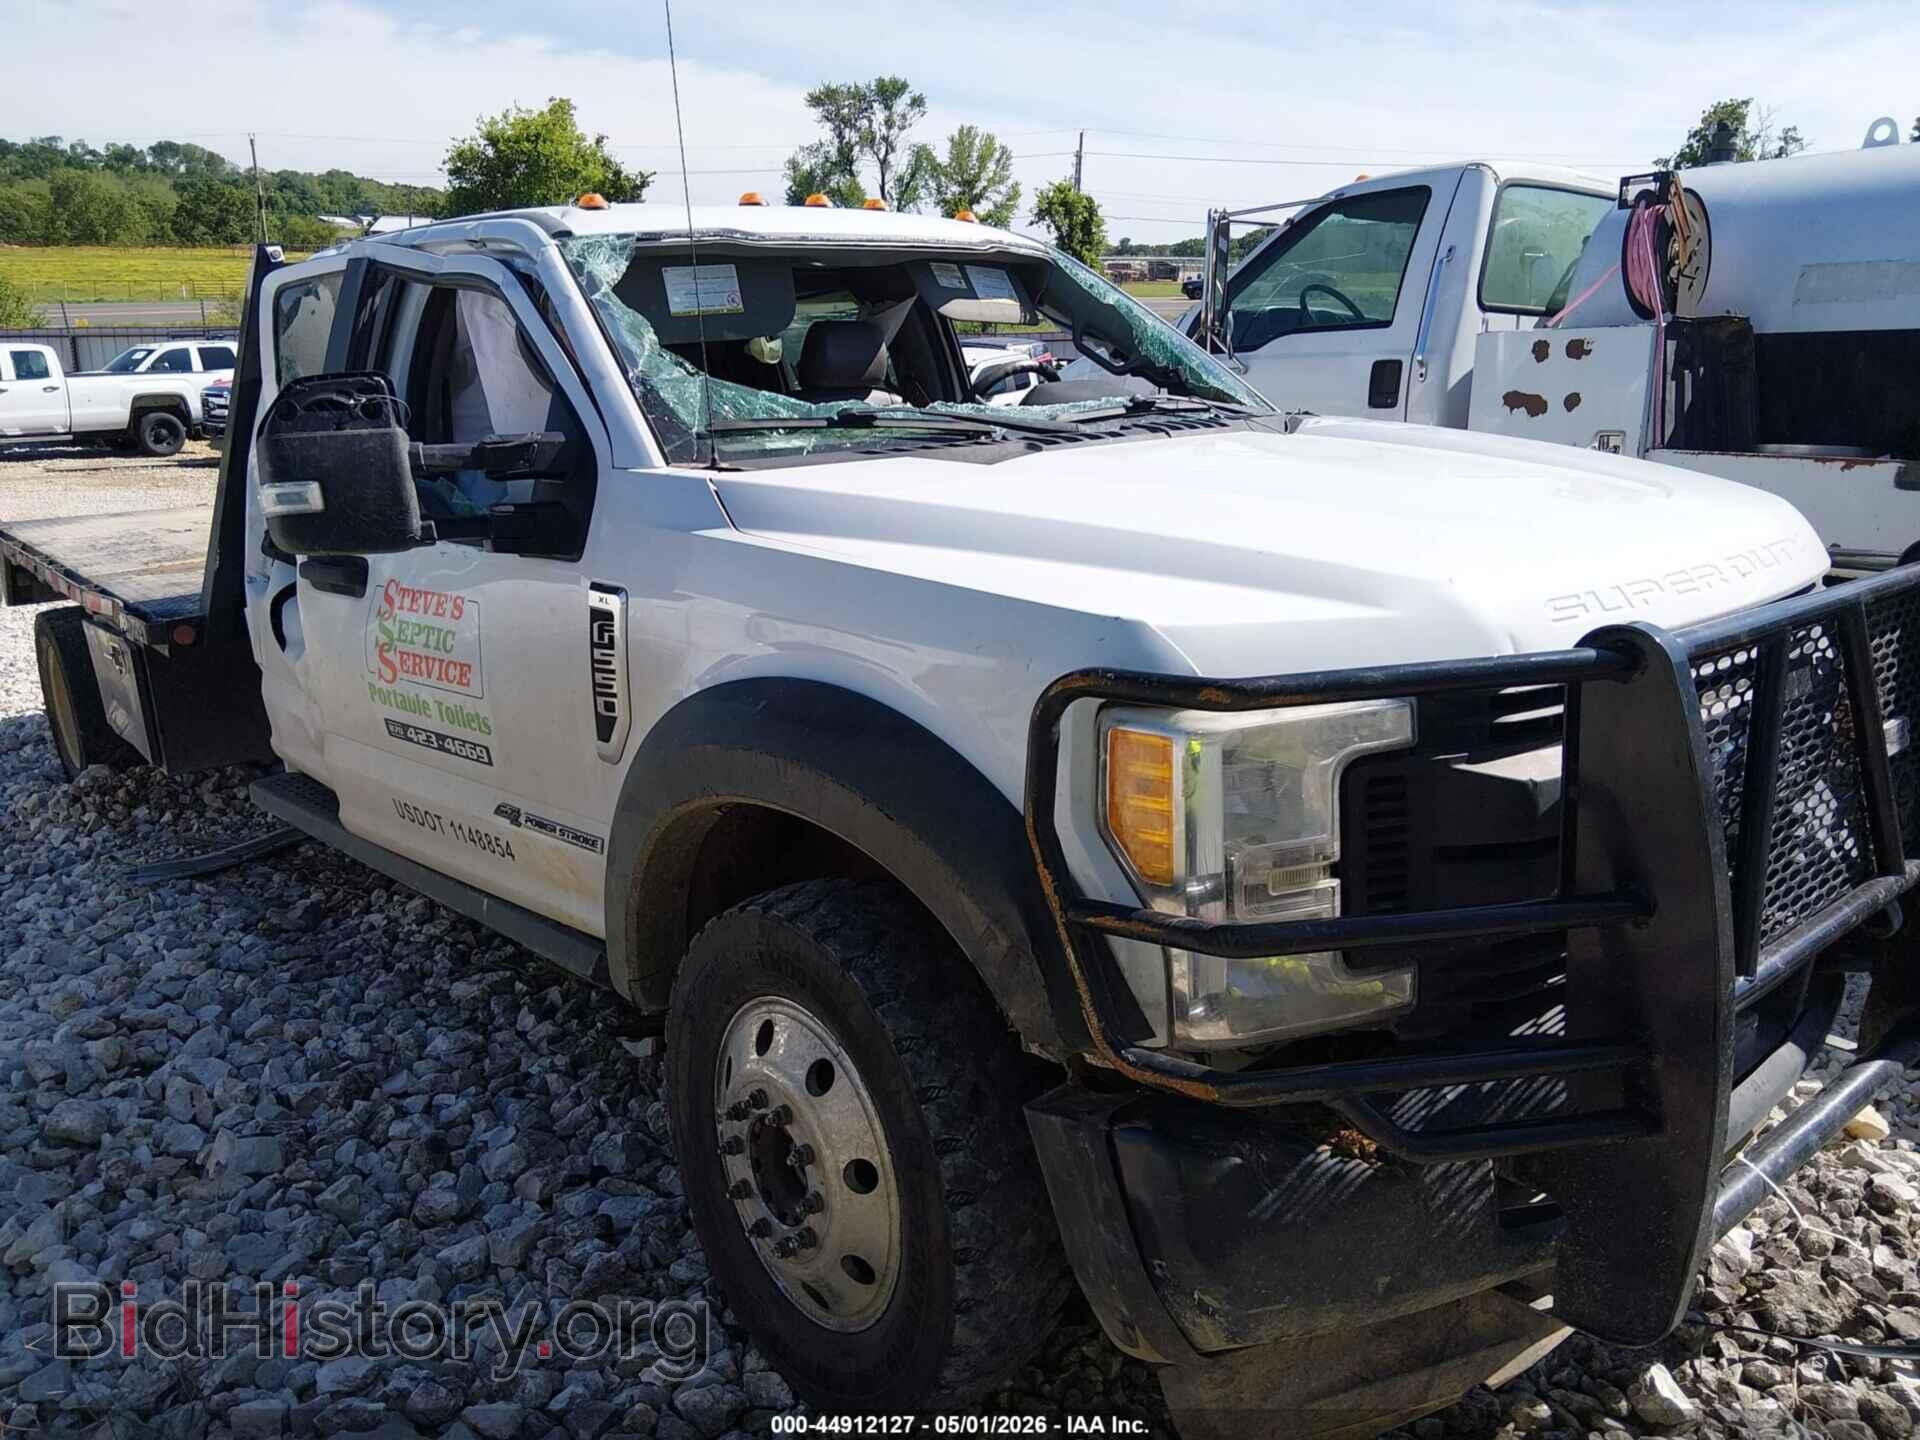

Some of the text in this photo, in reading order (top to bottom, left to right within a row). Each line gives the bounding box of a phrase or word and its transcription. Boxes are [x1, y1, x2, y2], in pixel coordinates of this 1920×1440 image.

[383, 579, 465, 621] STEVE'S
[598, 596, 610, 605] XL
[1543, 562, 1731, 623] SUPER
[376, 608, 456, 652] SEPTIC
[377, 640, 472, 688] SERVICE
[433, 698, 492, 735] Toilets
[392, 797, 516, 862] USDOT 1148854
[558, 828, 600, 849] STROKE
